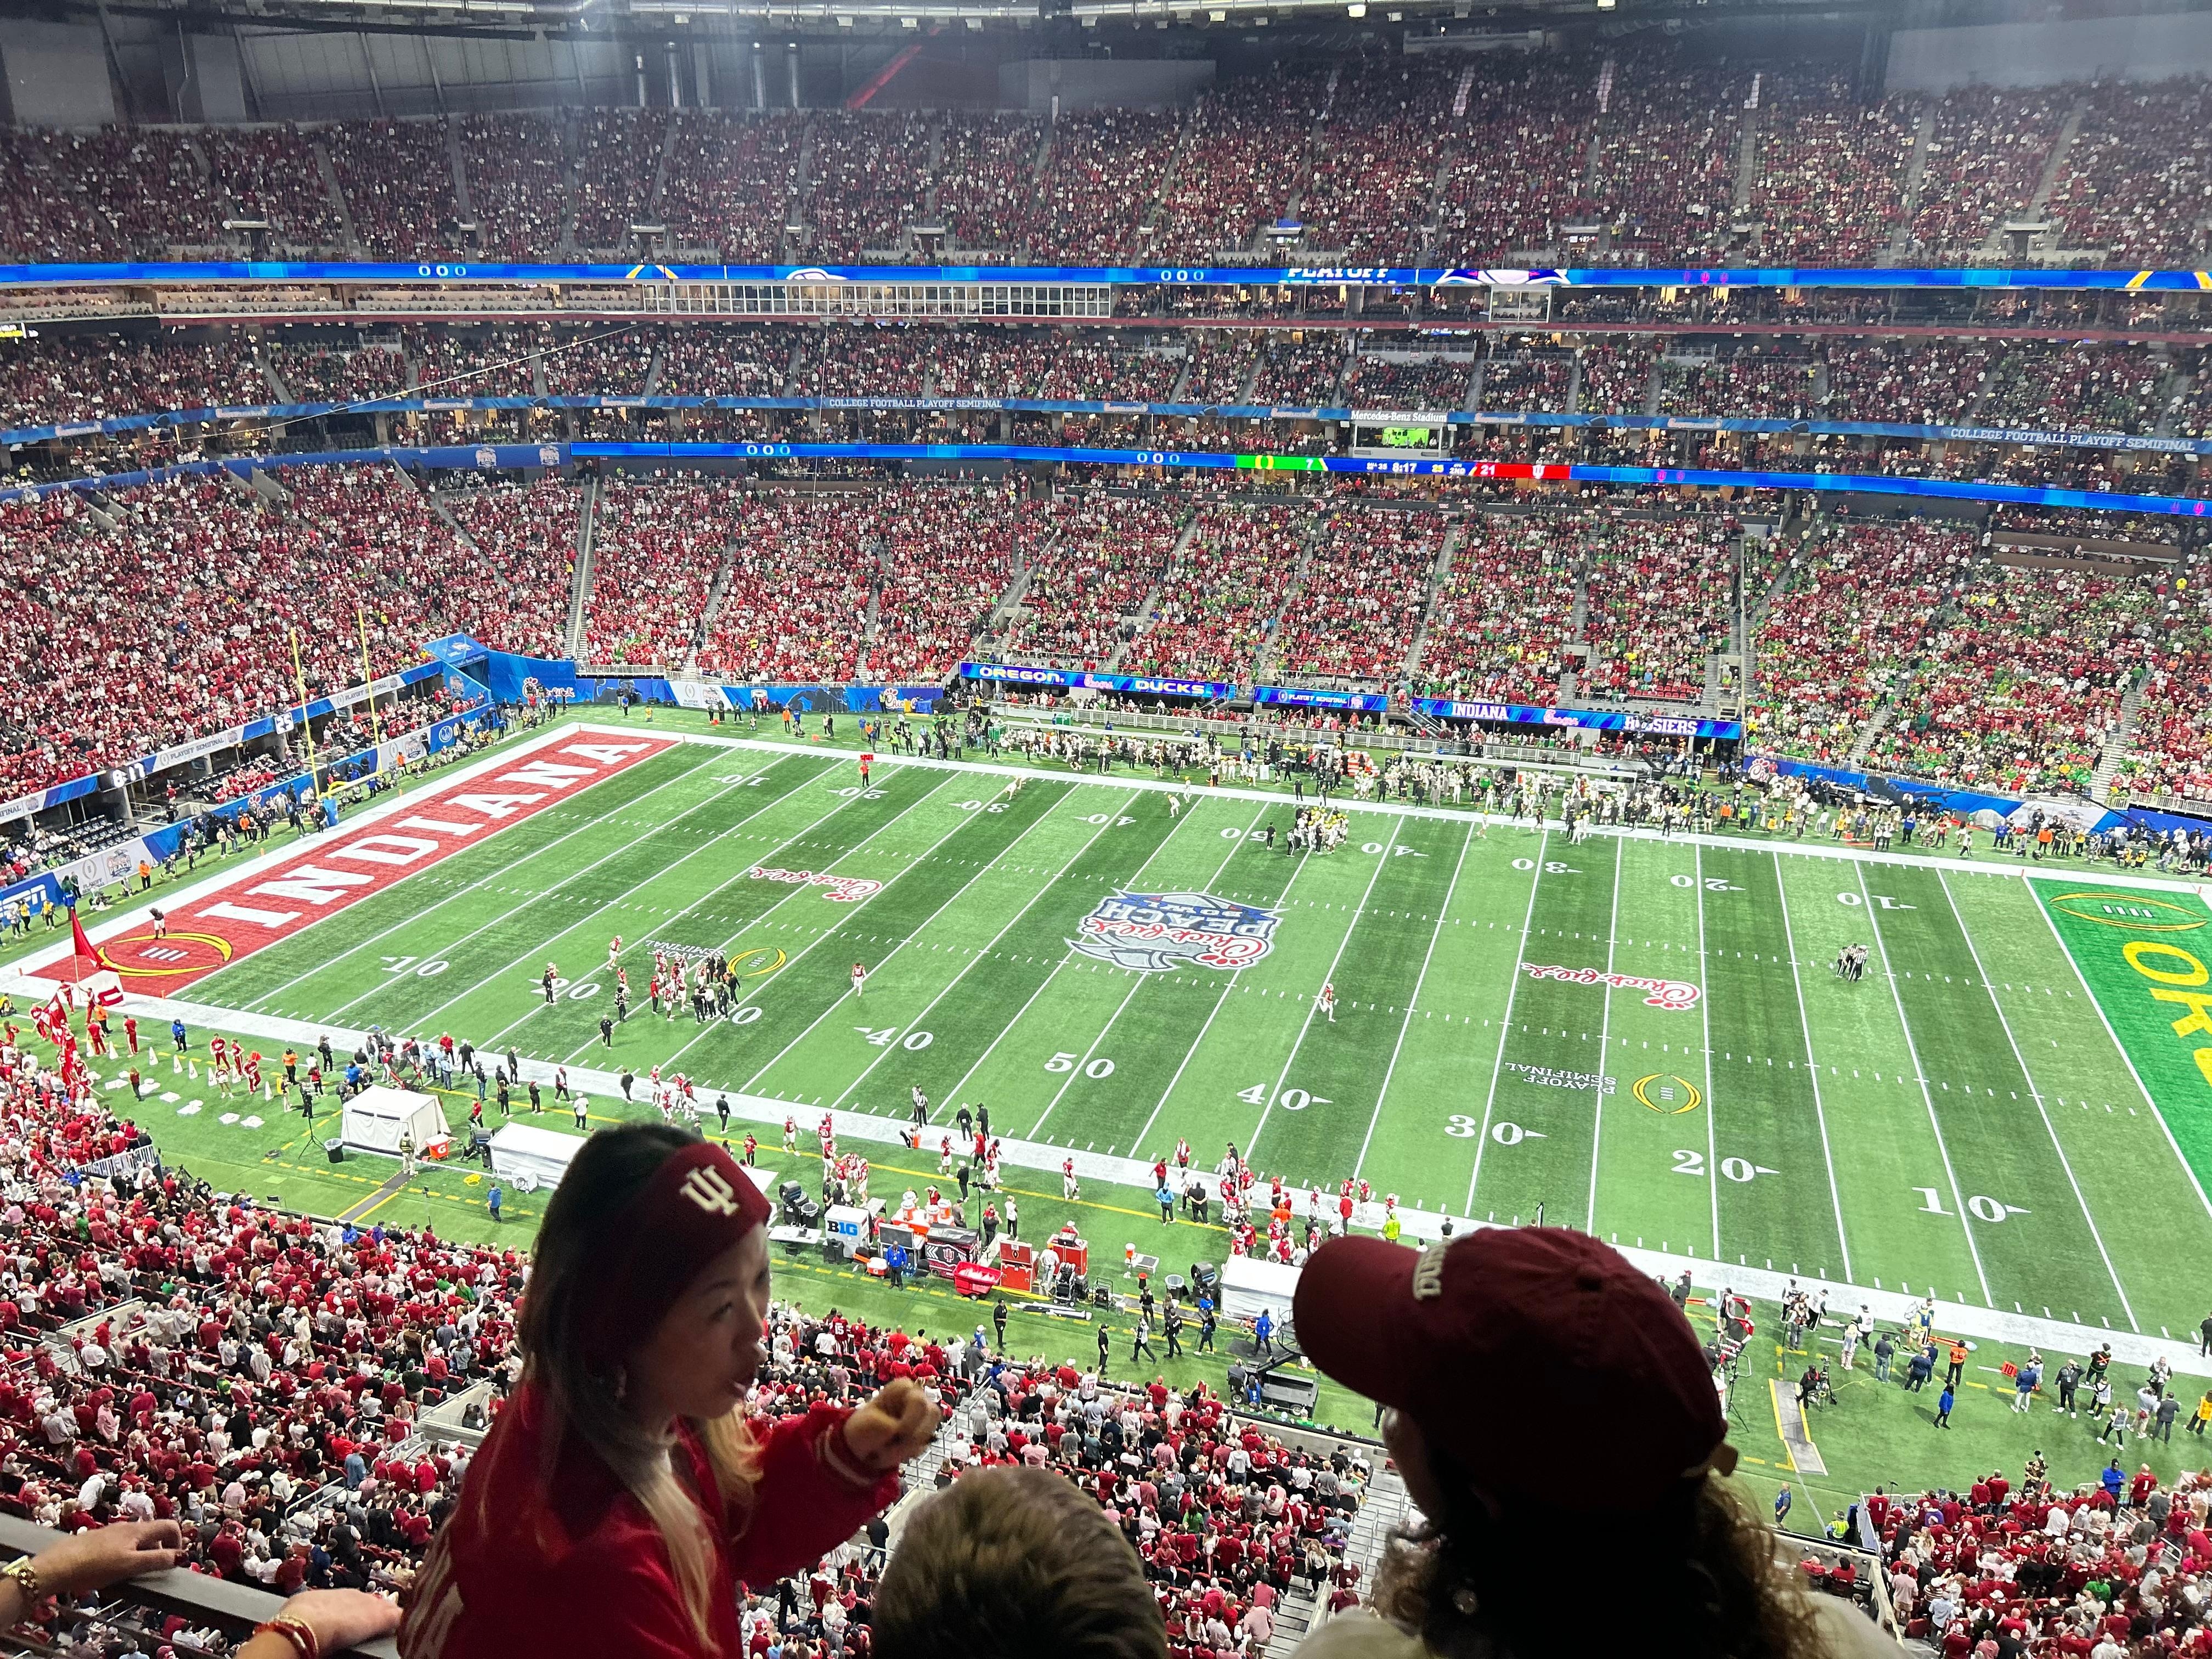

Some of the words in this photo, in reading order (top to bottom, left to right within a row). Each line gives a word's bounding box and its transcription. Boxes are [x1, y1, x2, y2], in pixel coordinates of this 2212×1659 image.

[829, 399, 868, 407] COLLEGE
[870, 399, 916, 408] FOOTBALL
[916, 399, 955, 408] PLAYOFF
[956, 400, 1002, 408] SEMIFINAL
[1351, 410, 1411, 421] Mercedes-Benz
[1412, 413, 1447, 422] Stadium
[1950, 428, 2002, 439] COLLEGE
[2004, 430, 2067, 444] FOOTBALL
[2069, 434, 2124, 447] PLAYOFF
[2126, 438, 2195, 451] SEMIFINAL
[1306, 458, 1313, 468] 7
[1392, 463, 1417, 472] 8:17
[1432, 464, 1444, 472] 25
[1480, 465, 1496, 475] 21
[1135, 680, 1205, 694] DUCKS
[1452, 703, 1509, 720] INDIANA
[276, 716, 291, 731] 25
[170, 747, 195, 760] PLAYOFF
[196, 737, 224, 751] SEMIFINAL
[194, 742, 654, 928] INDIANA
[1142, 900, 1243, 917] BOWL
[1098, 900, 1277, 939] PEACH
[1521, 962, 1701, 1011] Chick-fil-A
[865, 1027, 934, 1051] 40
[1043, 1051, 1115, 1079] 50
[1504, 1062, 1617, 1085] SEMIFINAL
[1522, 1075, 1616, 1095] PLAYOFF
[1236, 1083, 1311, 1110] 40
[1444, 1114, 1523, 1146] 30
[1671, 1149, 1754, 1182] 20
[1911, 1187, 2007, 1223] 10
[834, 1325, 844, 1334] 15
[2003, 1363, 2014, 1374] 10
[1187, 1418, 1190, 1427] 1
[2143, 1480, 2149, 1491] 1
[1878, 1502, 1882, 1511] 1
[2183, 1516, 2189, 1525] 1
[1942, 1554, 1952, 1563] 15
[1284, 1564, 1289, 1572] 1
